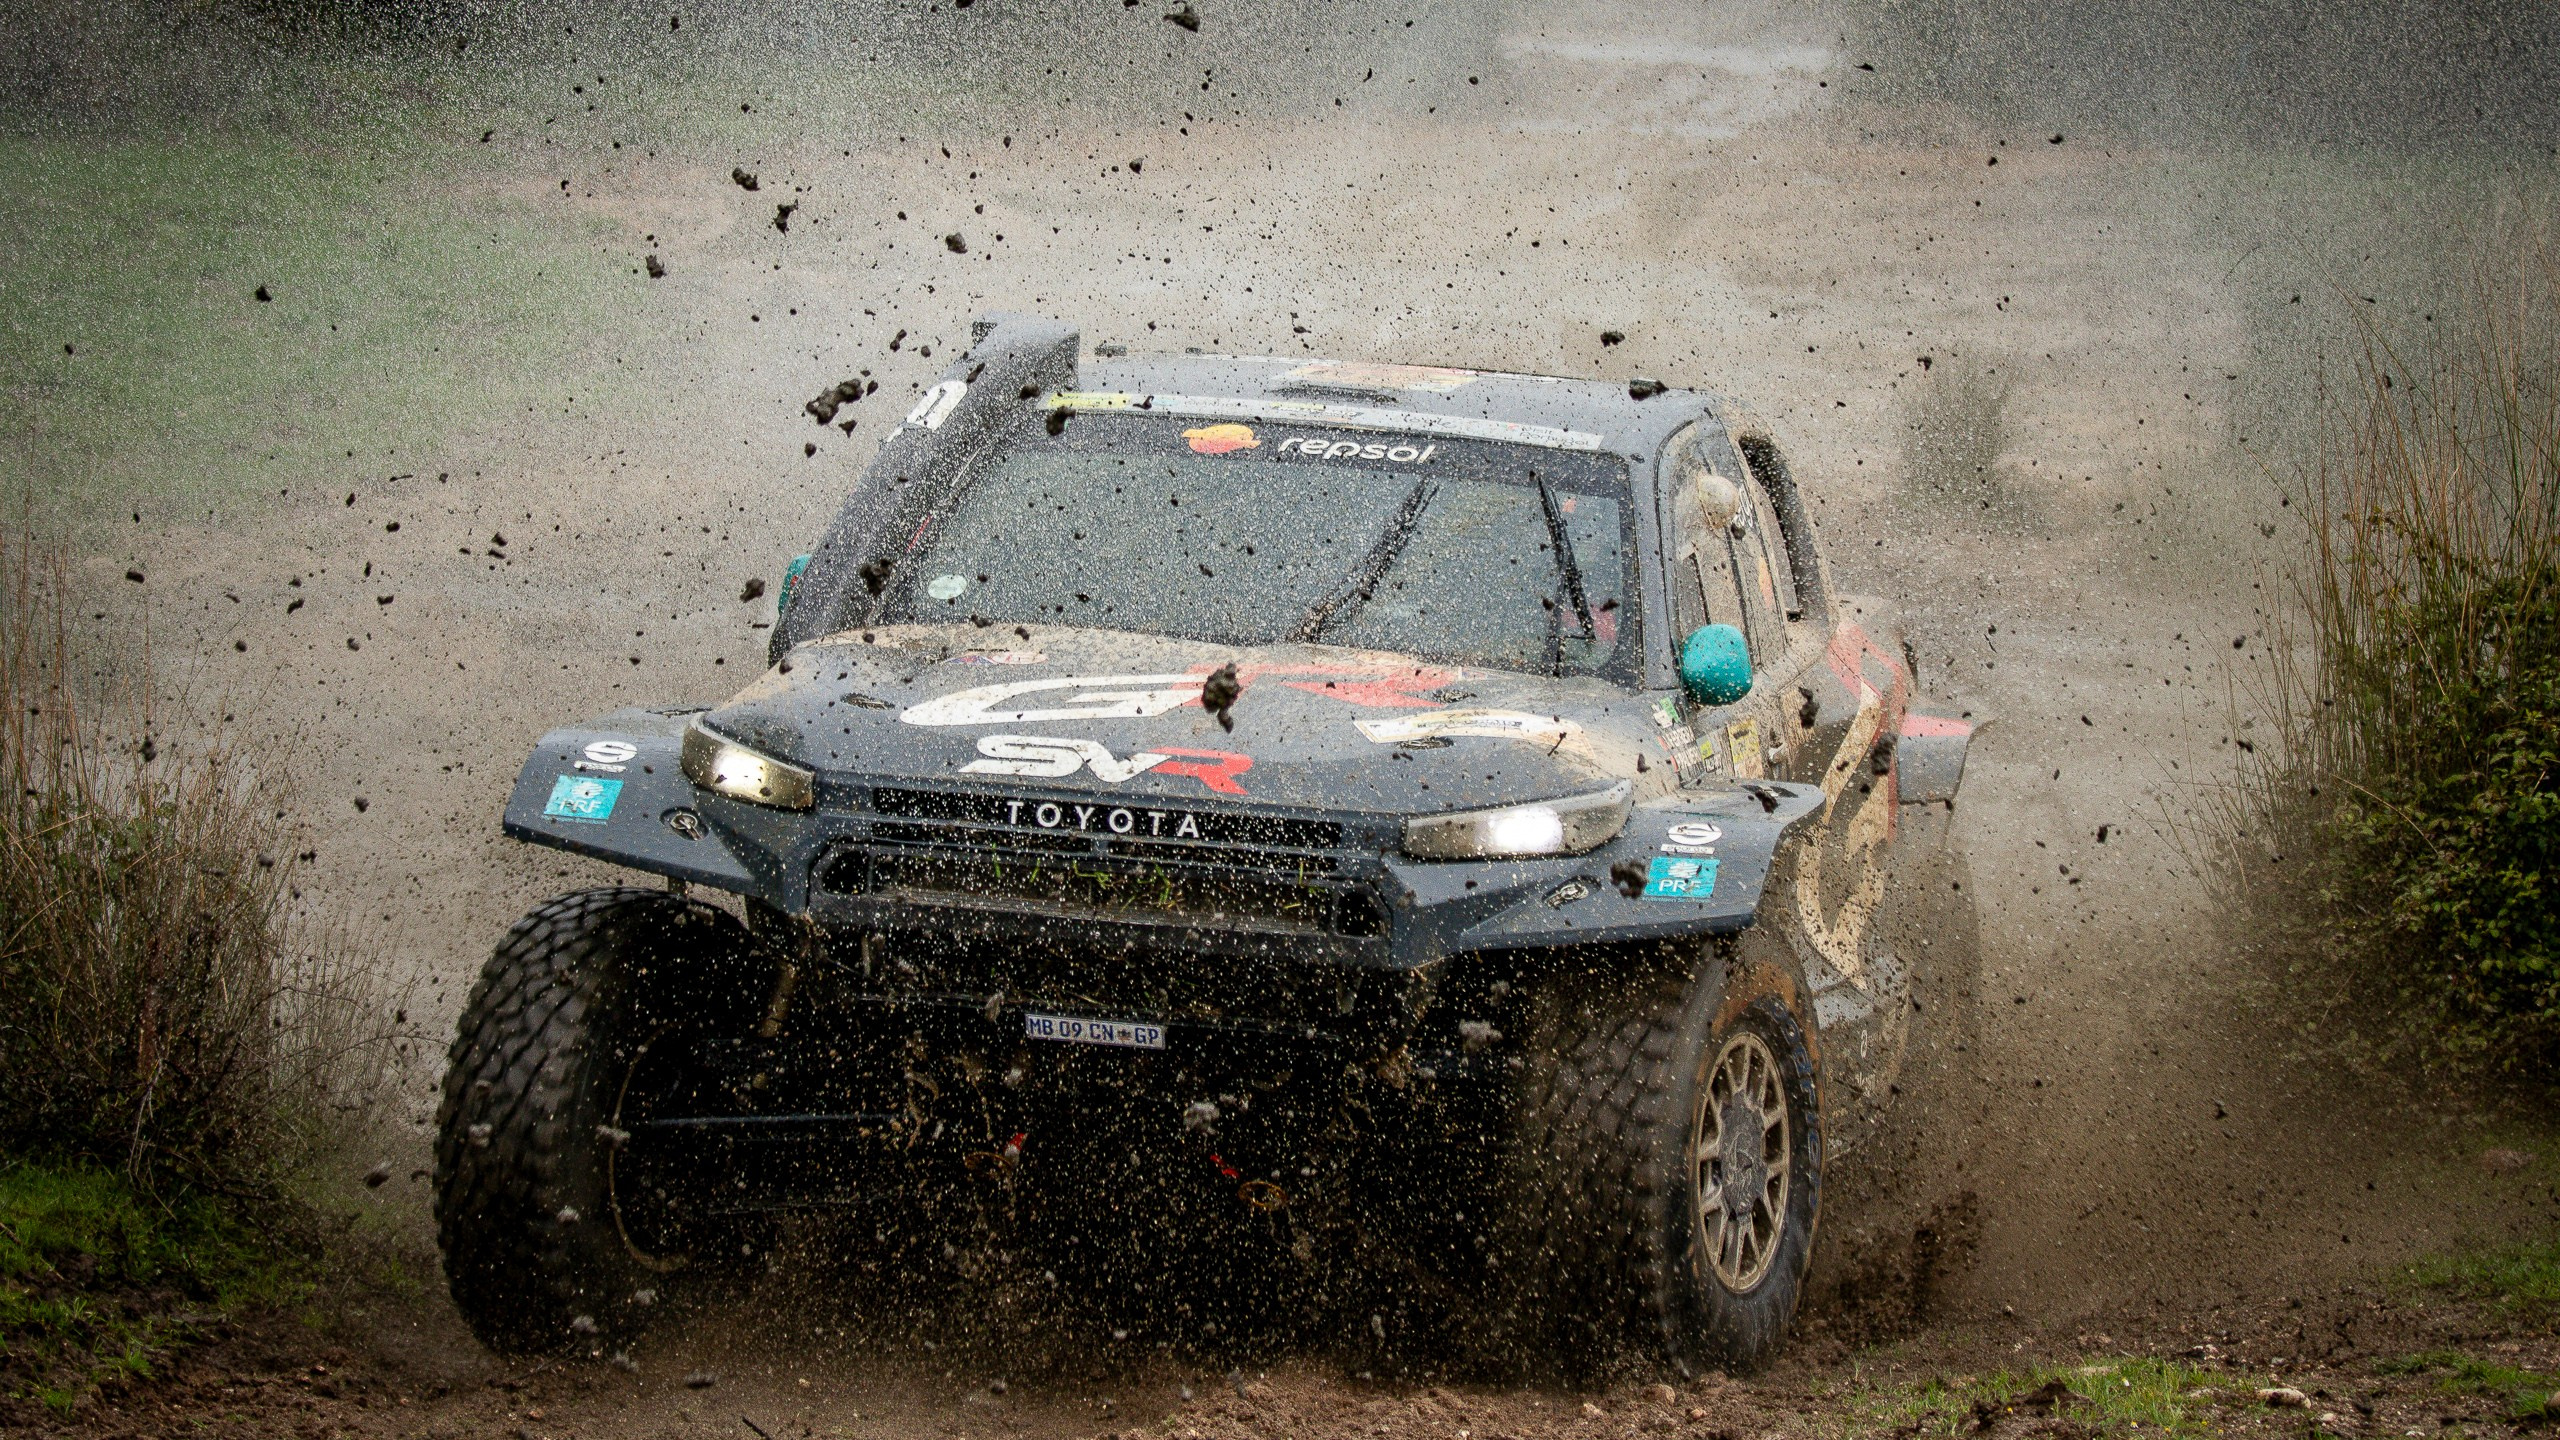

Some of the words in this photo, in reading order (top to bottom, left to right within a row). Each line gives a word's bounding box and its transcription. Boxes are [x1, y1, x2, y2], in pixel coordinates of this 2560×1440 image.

[1278, 438, 1436, 464] repsol
[560, 799, 602, 814] PRF
[1006, 800, 1201, 838] TOYOTA
[1029, 1017, 1054, 1036] MB
[1058, 1021, 1083, 1038] 09
[1089, 1023, 1114, 1041] CN
[1134, 1027, 1159, 1044] GP
